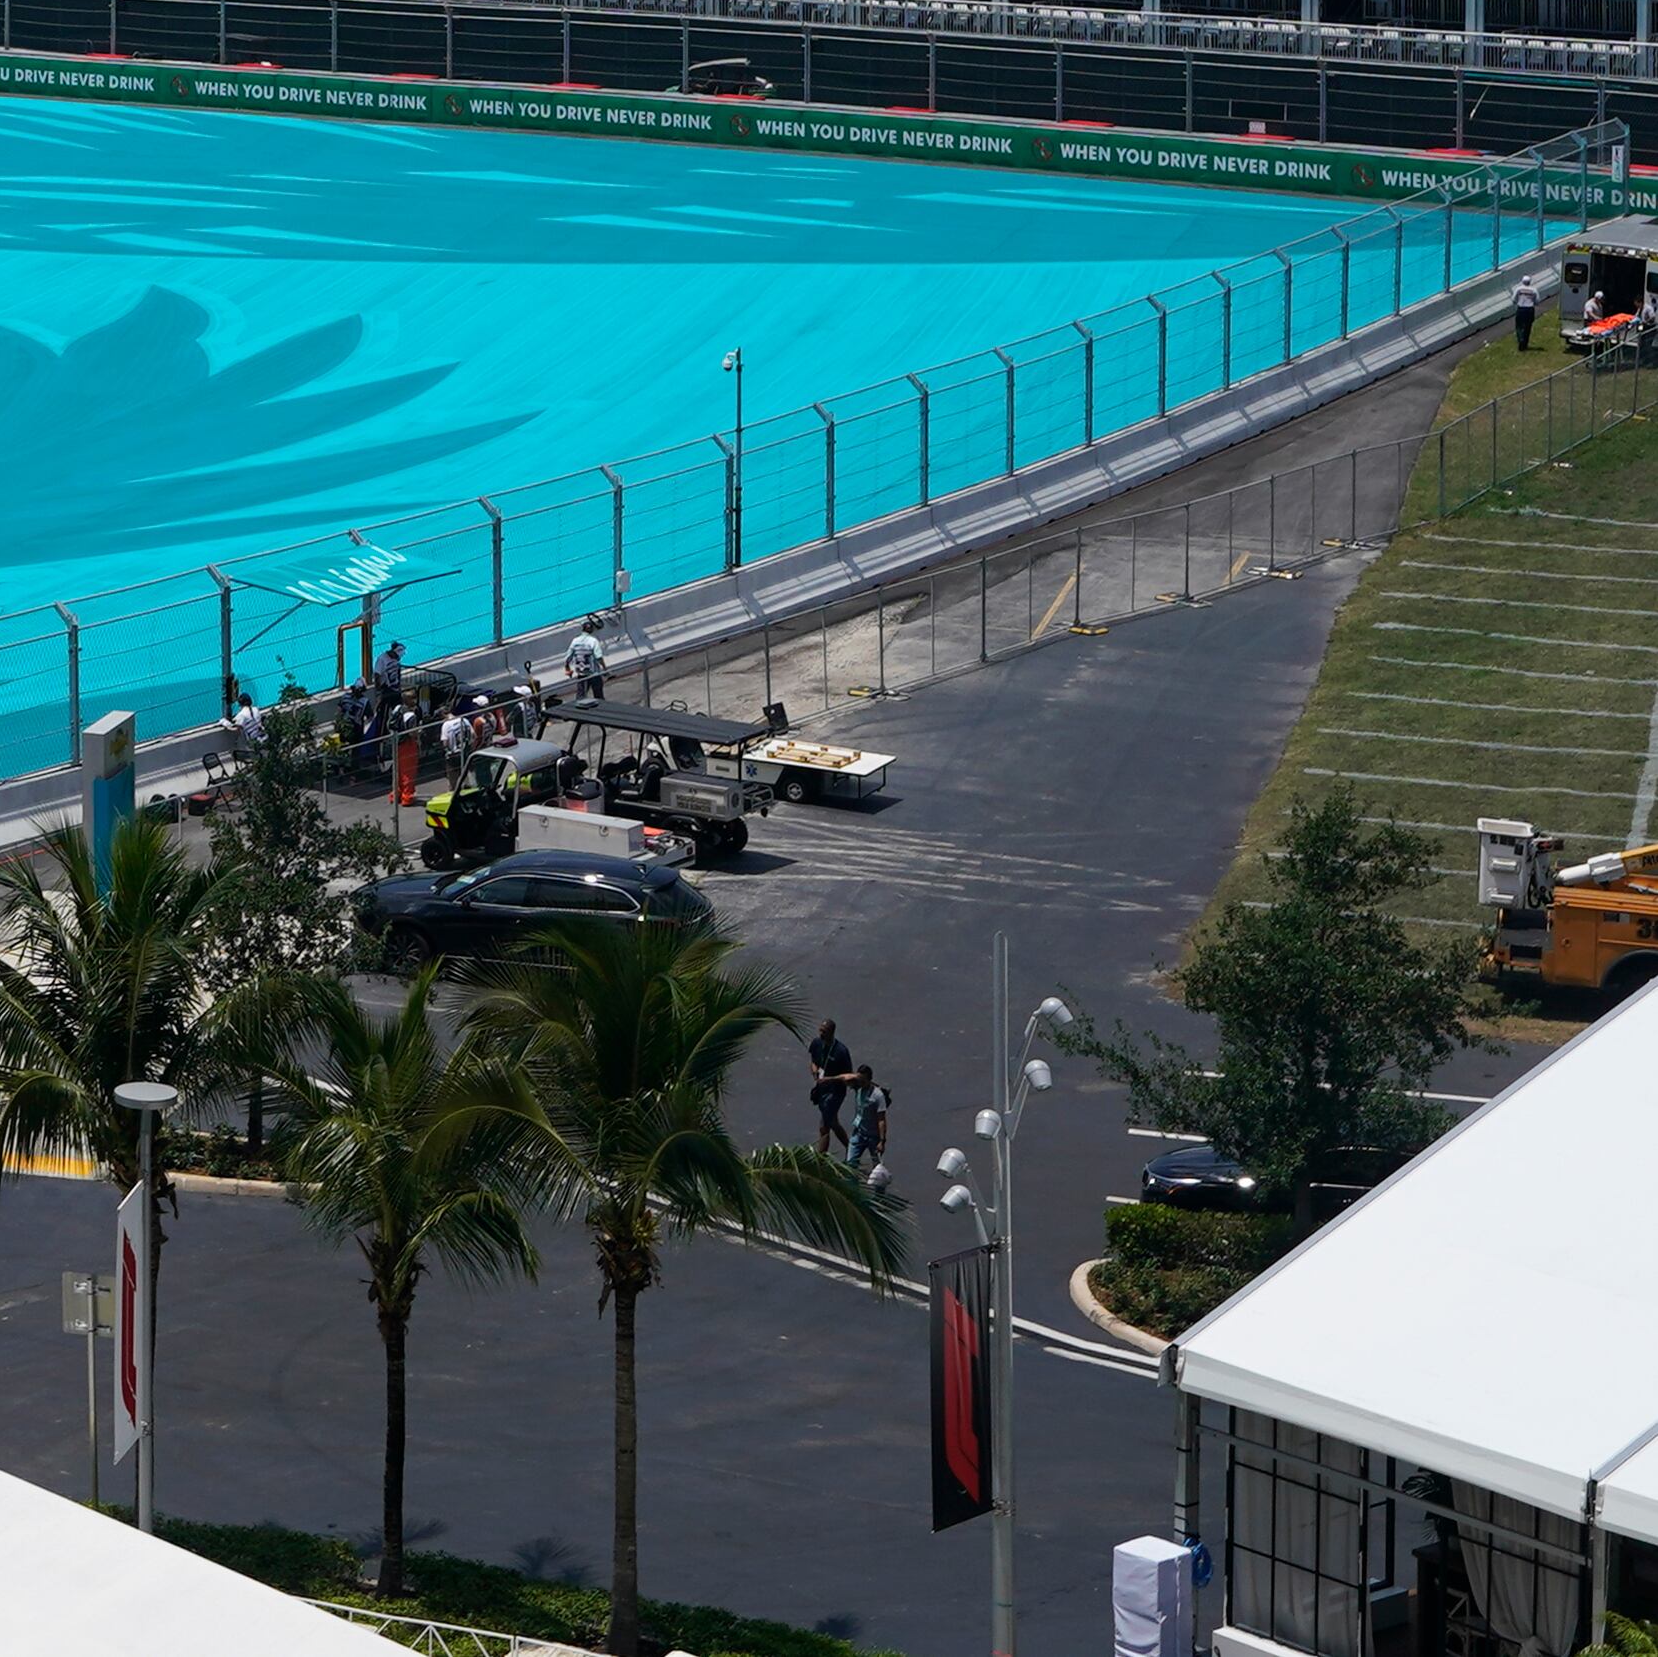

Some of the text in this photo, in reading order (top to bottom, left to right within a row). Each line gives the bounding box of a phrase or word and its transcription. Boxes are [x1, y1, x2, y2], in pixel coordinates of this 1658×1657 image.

[14, 68, 55, 85] DRIVE
[59, 71, 105, 88] NEVER
[109, 75, 154, 92] DRINK
[194, 80, 427, 111] WHEN YOU DRIVE NEVER DRINK
[469, 99, 713, 130] WHEN YOU DRIVE NEVER DRINK
[756, 119, 1013, 154] WHEN YOU DRIVE NEVER DRINK
[1060, 142, 1332, 181] WHEN YOU DRIVE NEVER DRINK
[1382, 169, 1436, 189] WHEN
[1442, 173, 1481, 193] YOU
